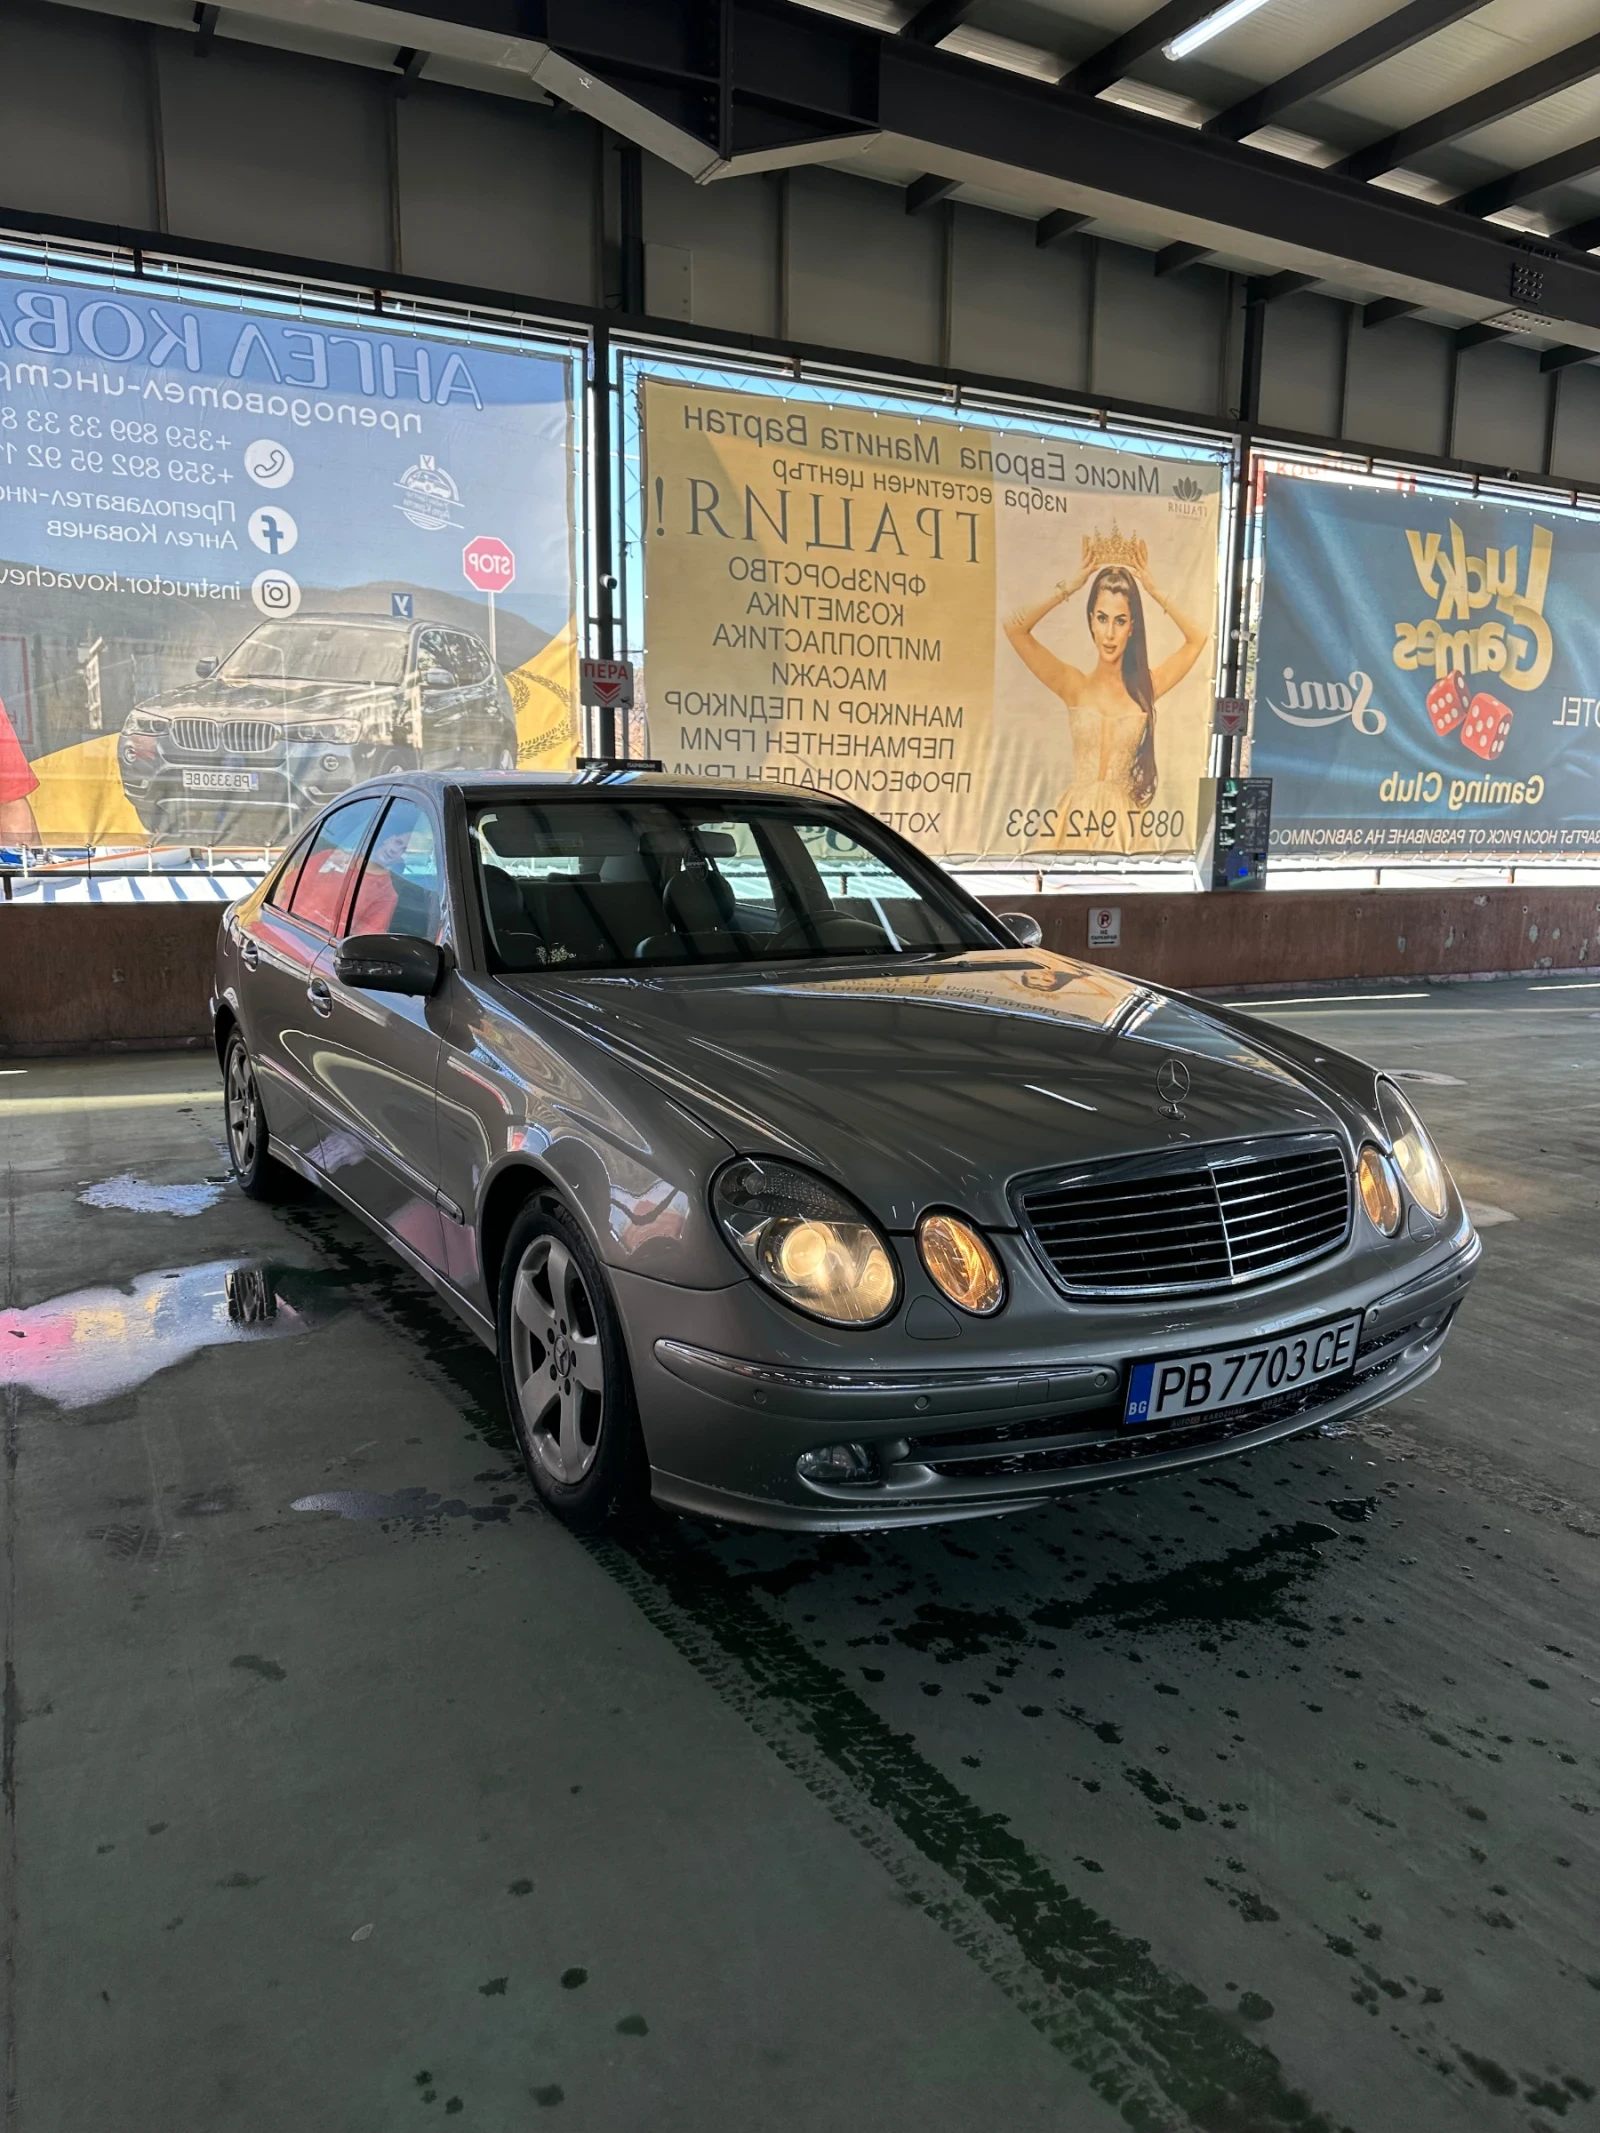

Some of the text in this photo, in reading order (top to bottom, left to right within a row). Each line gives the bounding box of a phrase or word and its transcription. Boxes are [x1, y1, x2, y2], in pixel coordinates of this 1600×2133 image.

[584, 662, 629, 680] ПЕРА
[1216, 700, 1246, 714] ПЕРА
[1155, 1322, 1355, 1413] PB 7703 CE
[1128, 1400, 1147, 1416] BG
[1203, 1407, 1245, 1421] KARDZHALI
